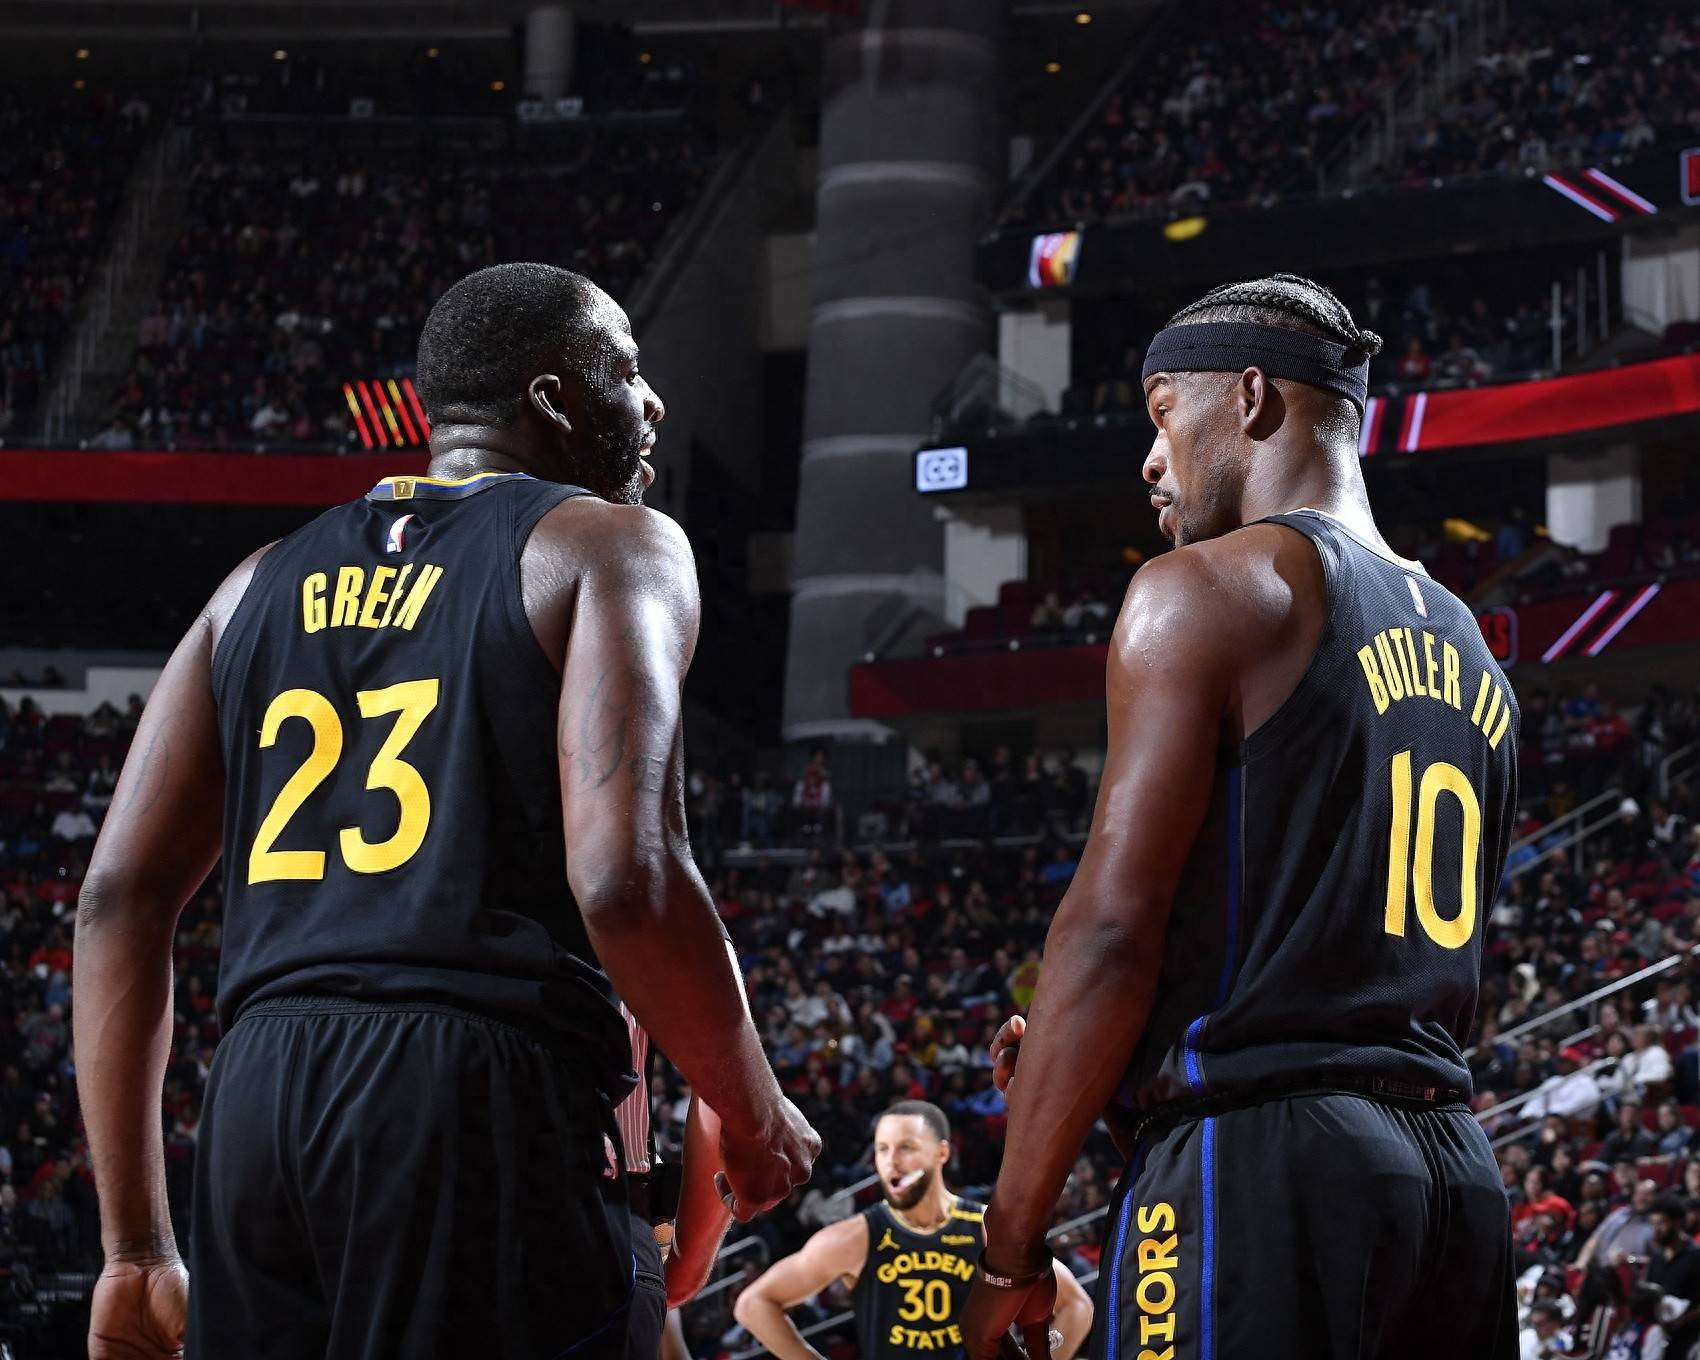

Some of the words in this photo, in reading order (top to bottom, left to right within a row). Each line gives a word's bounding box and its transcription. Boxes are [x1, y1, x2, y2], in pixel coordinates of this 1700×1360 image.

[1356, 627, 1462, 716] BUTLER
[1470, 669, 1511, 751] III
[247, 678, 440, 886] 23
[1384, 750, 1481, 950] 10
[876, 1250, 975, 1284] GOLDEN
[896, 1278, 952, 1322] 30
[888, 1324, 962, 1351] STATE
